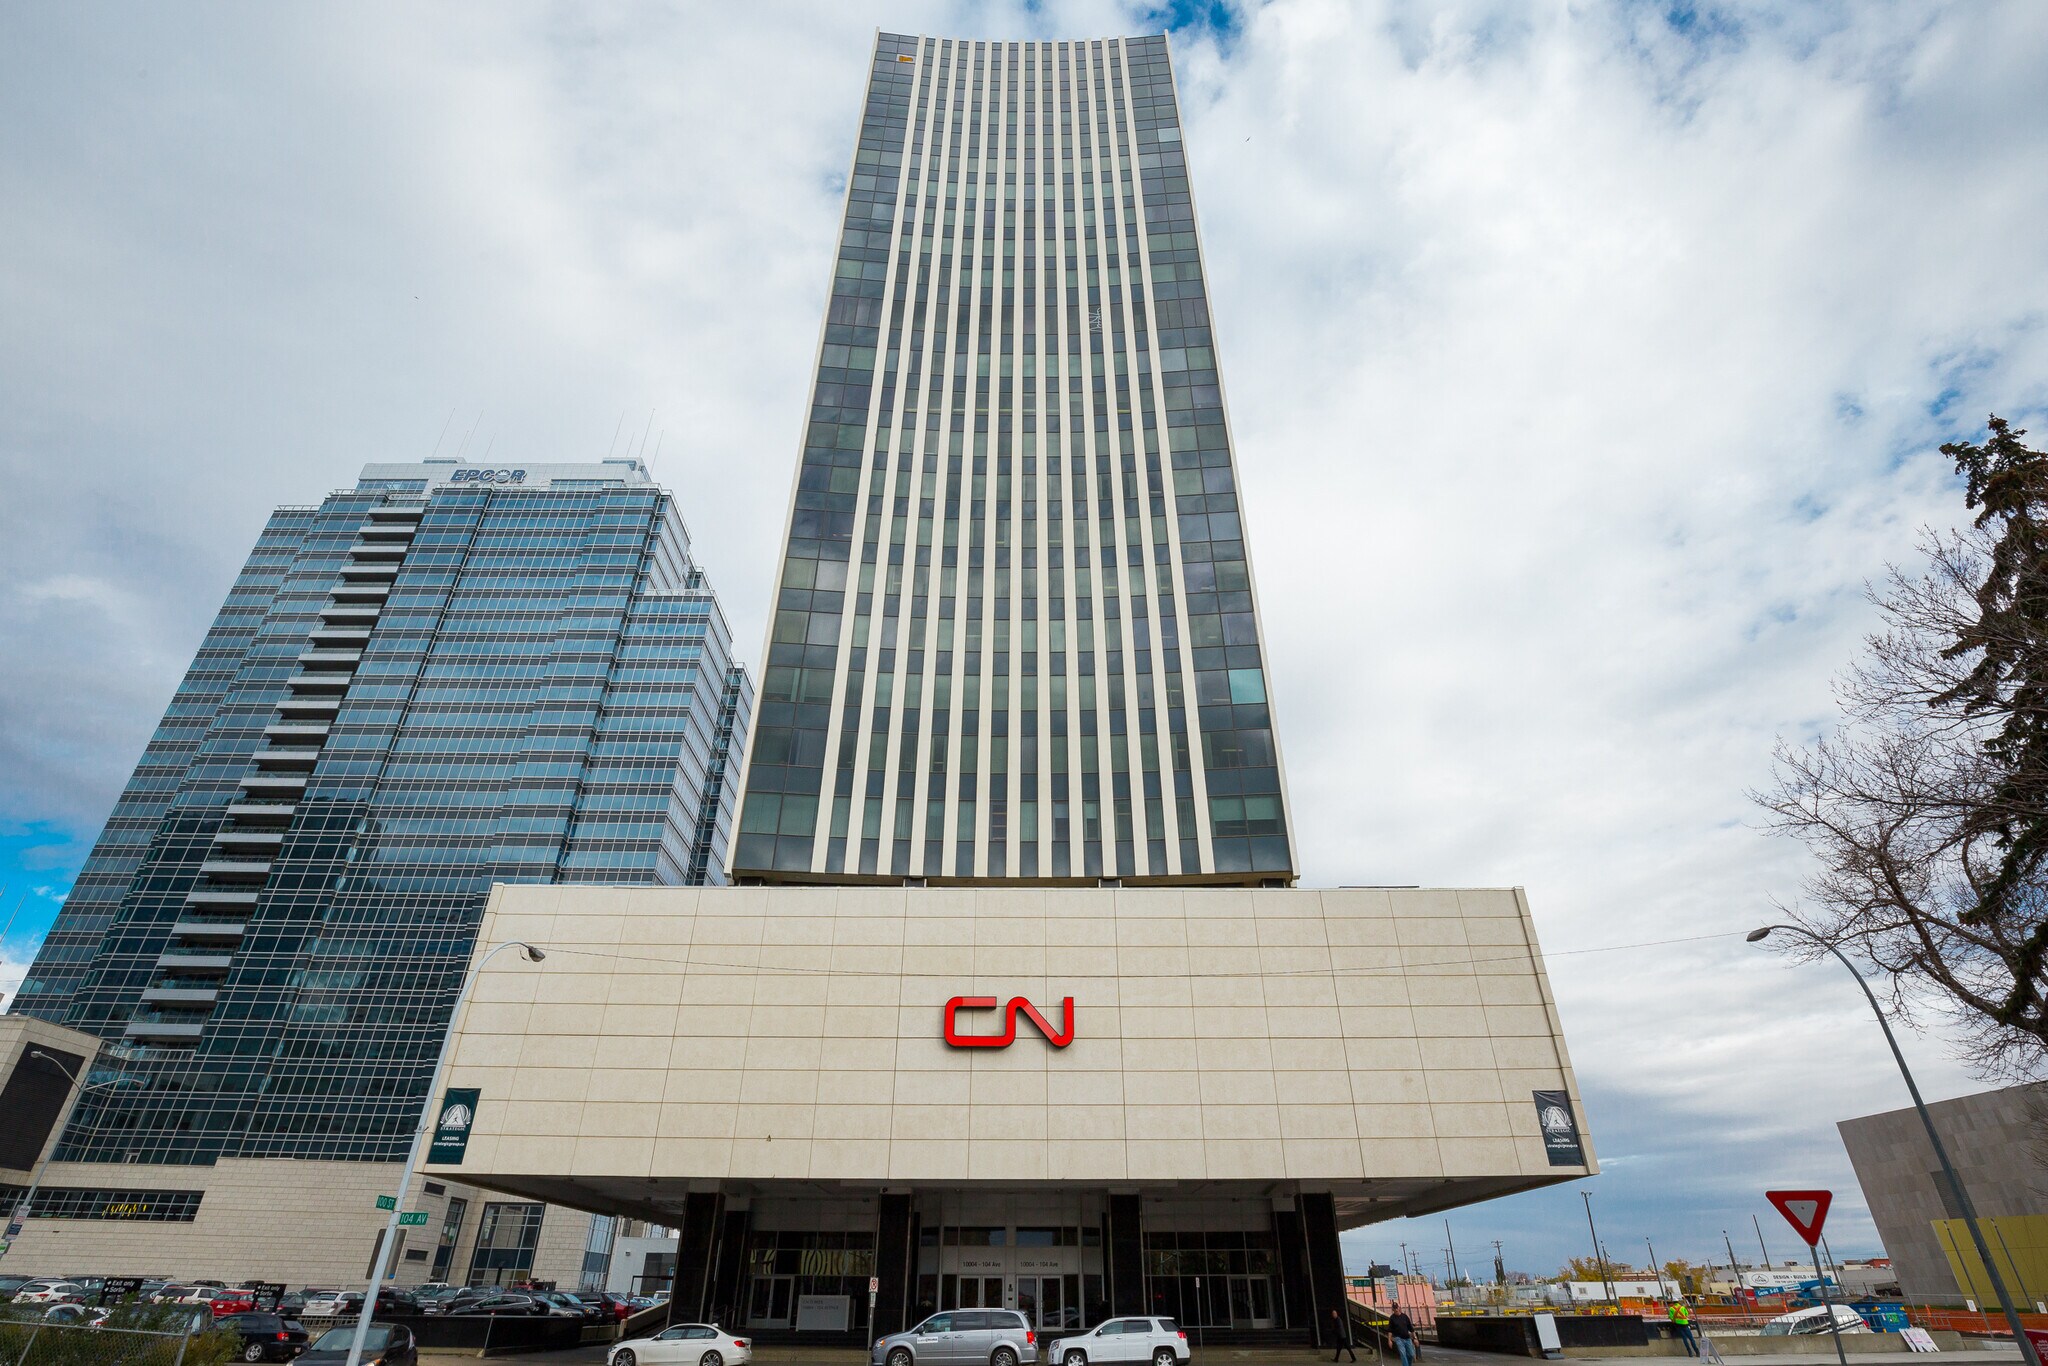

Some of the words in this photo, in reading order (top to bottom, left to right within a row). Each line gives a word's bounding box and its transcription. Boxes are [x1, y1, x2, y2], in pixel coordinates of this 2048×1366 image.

[450, 469, 528, 483] EPCOR
[944, 996, 1075, 1048] CN
[378, 1196, 387, 1207] 100
[387, 1198, 395, 1208] ST
[400, 1213, 414, 1224] 104
[416, 1214, 427, 1224] AV
